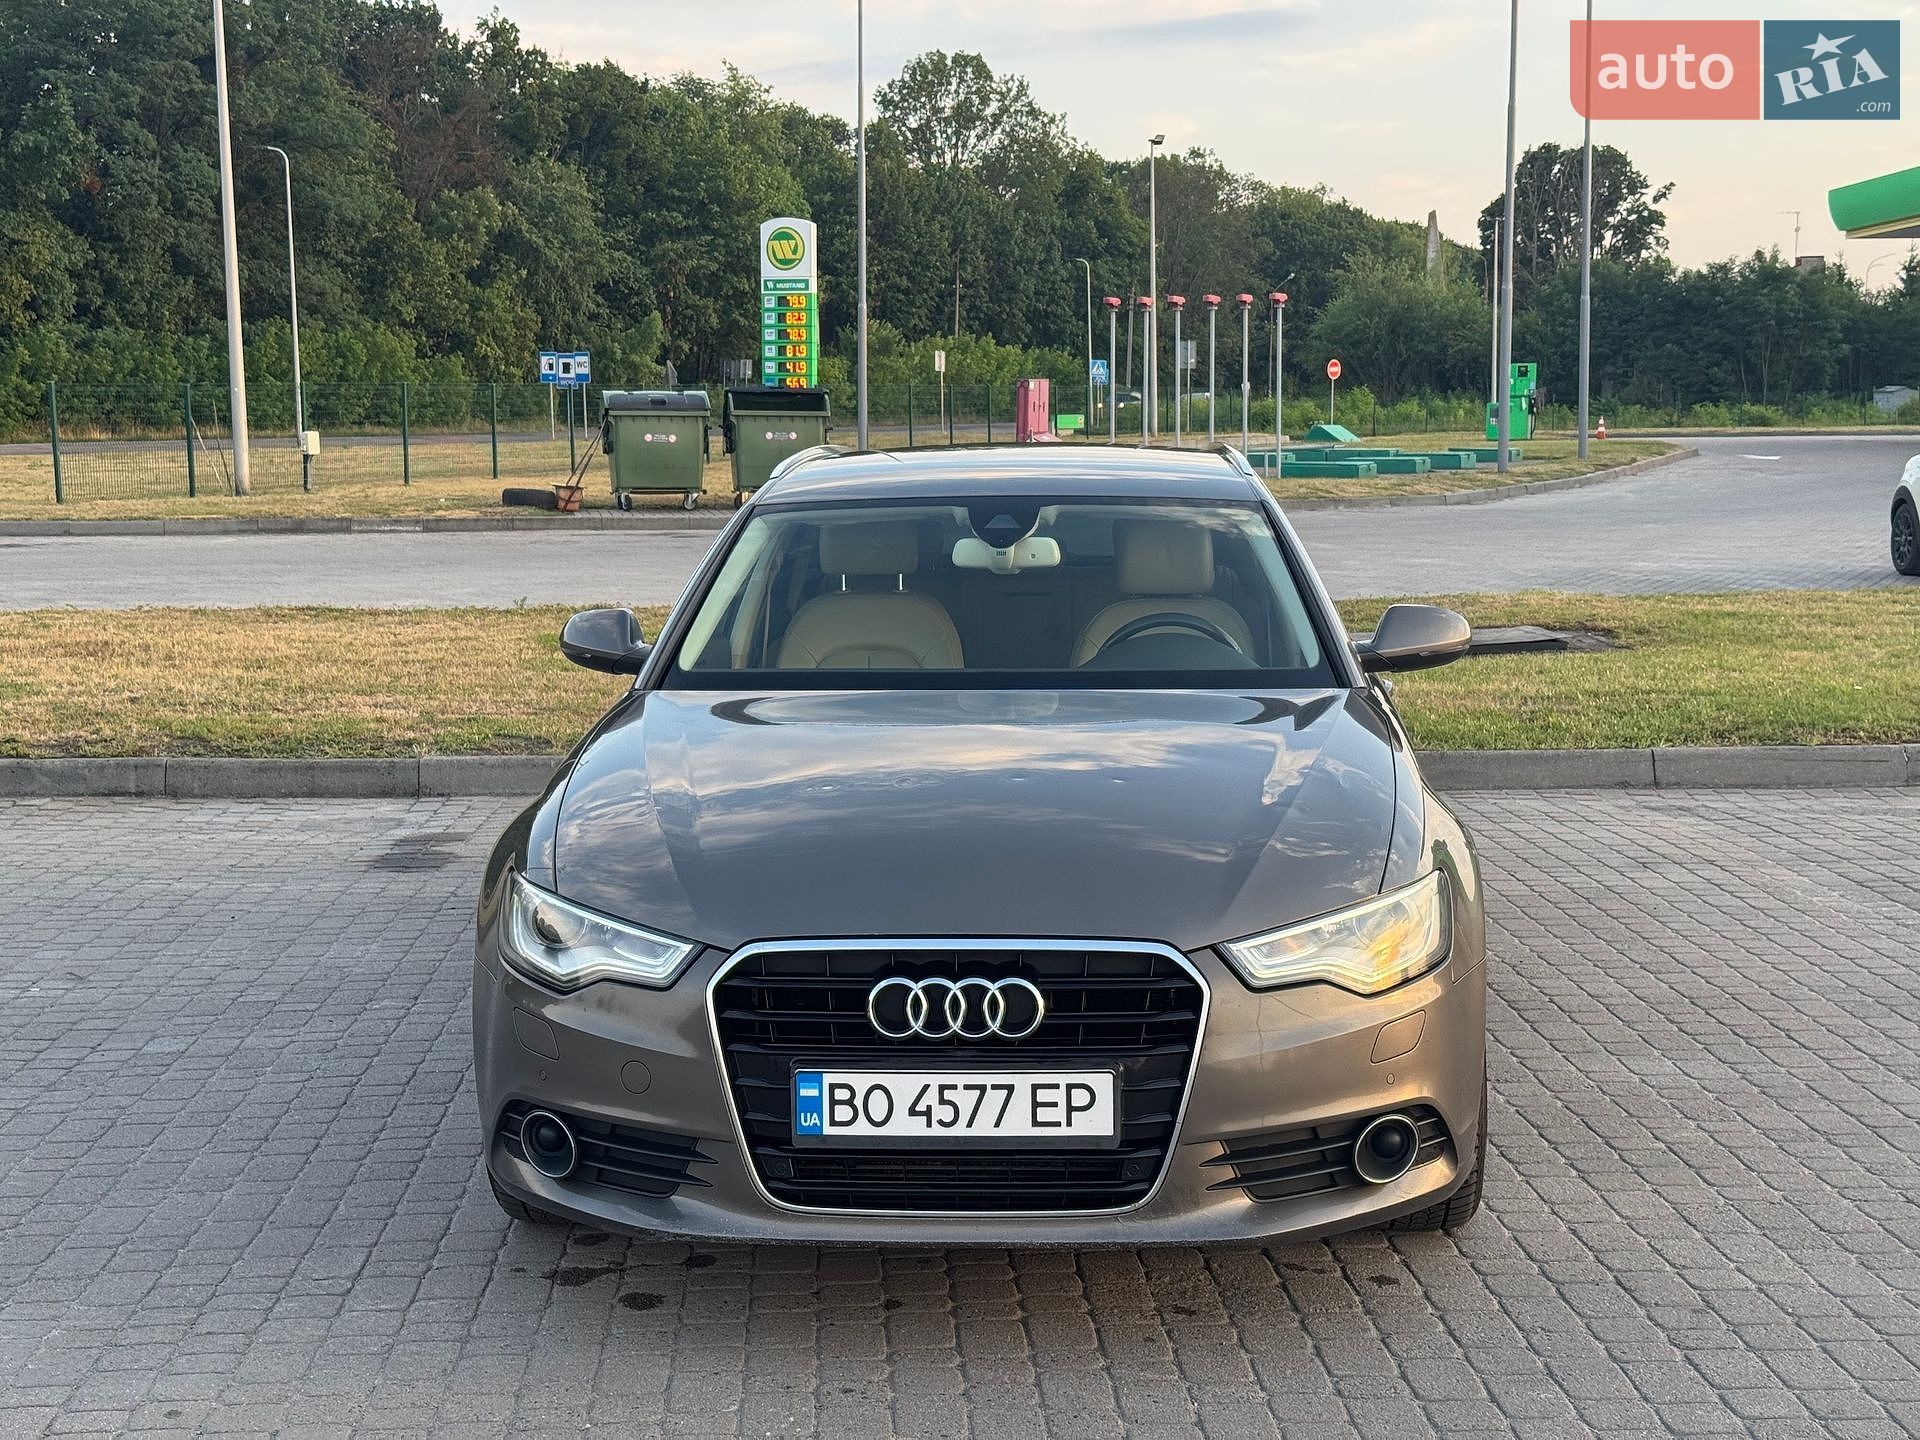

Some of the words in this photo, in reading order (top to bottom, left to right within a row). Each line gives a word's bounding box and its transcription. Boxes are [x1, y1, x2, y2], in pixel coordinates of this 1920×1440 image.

[577, 361, 588, 369] WC
[828, 1083, 894, 1128] BO
[908, 1083, 1016, 1129] 4577
[1030, 1083, 1097, 1127] EP
[801, 1112, 821, 1127] UA
